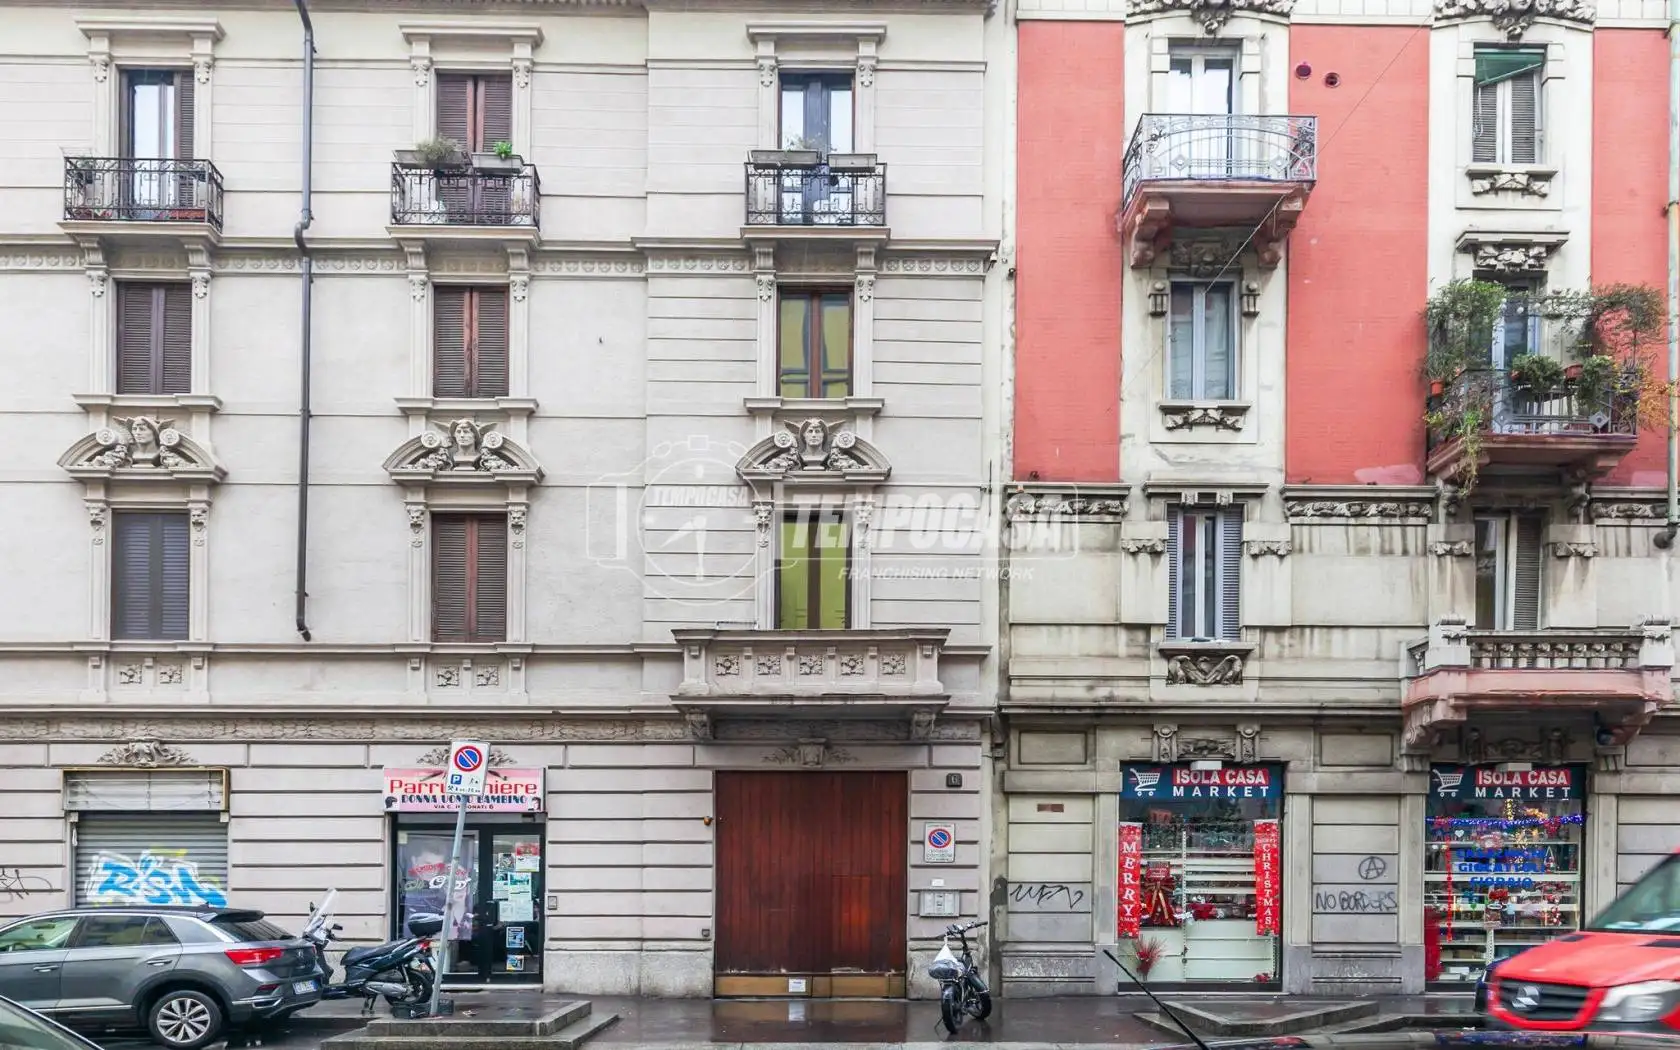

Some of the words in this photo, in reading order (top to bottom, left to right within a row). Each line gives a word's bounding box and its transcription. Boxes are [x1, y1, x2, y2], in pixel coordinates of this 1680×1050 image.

[1176, 769, 1220, 784] ISOLA
[1225, 769, 1266, 784] CASA
[1478, 770, 1522, 785] ISOLA
[1527, 770, 1567, 785] CASA
[401, 794, 438, 804] DONNA
[477, 794, 528, 804] BAMBINO
[1173, 786, 1269, 797] MARKET
[1475, 787, 1571, 798] MARKET
[1122, 841, 1138, 917] MERRY
[1262, 843, 1273, 925] CHRISTMAS
[1316, 891, 1337, 910] NO
